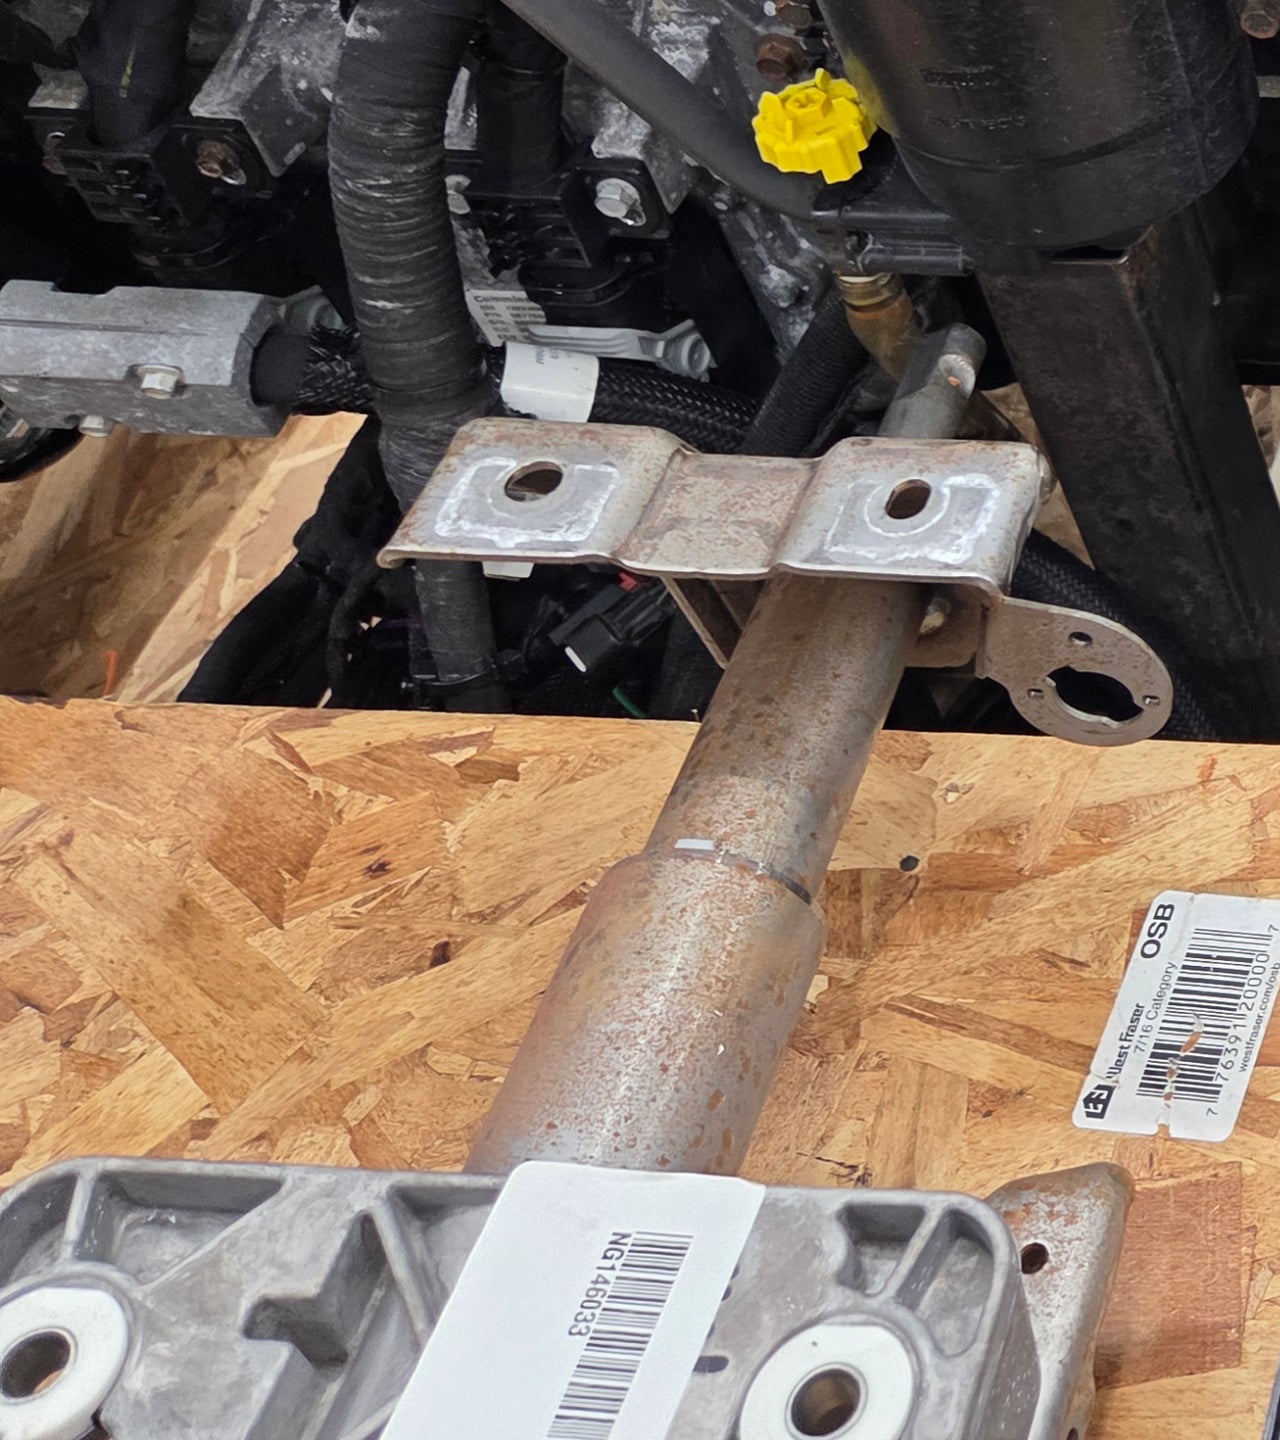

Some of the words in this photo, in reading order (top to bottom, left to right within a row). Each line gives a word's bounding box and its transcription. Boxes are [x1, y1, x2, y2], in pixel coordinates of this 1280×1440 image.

[1141, 903, 1174, 957] OSB
[1145, 961, 1177, 1018] Category
[1239, 953, 1269, 1011] 20000
[568, 1232, 632, 1336] NG146033
